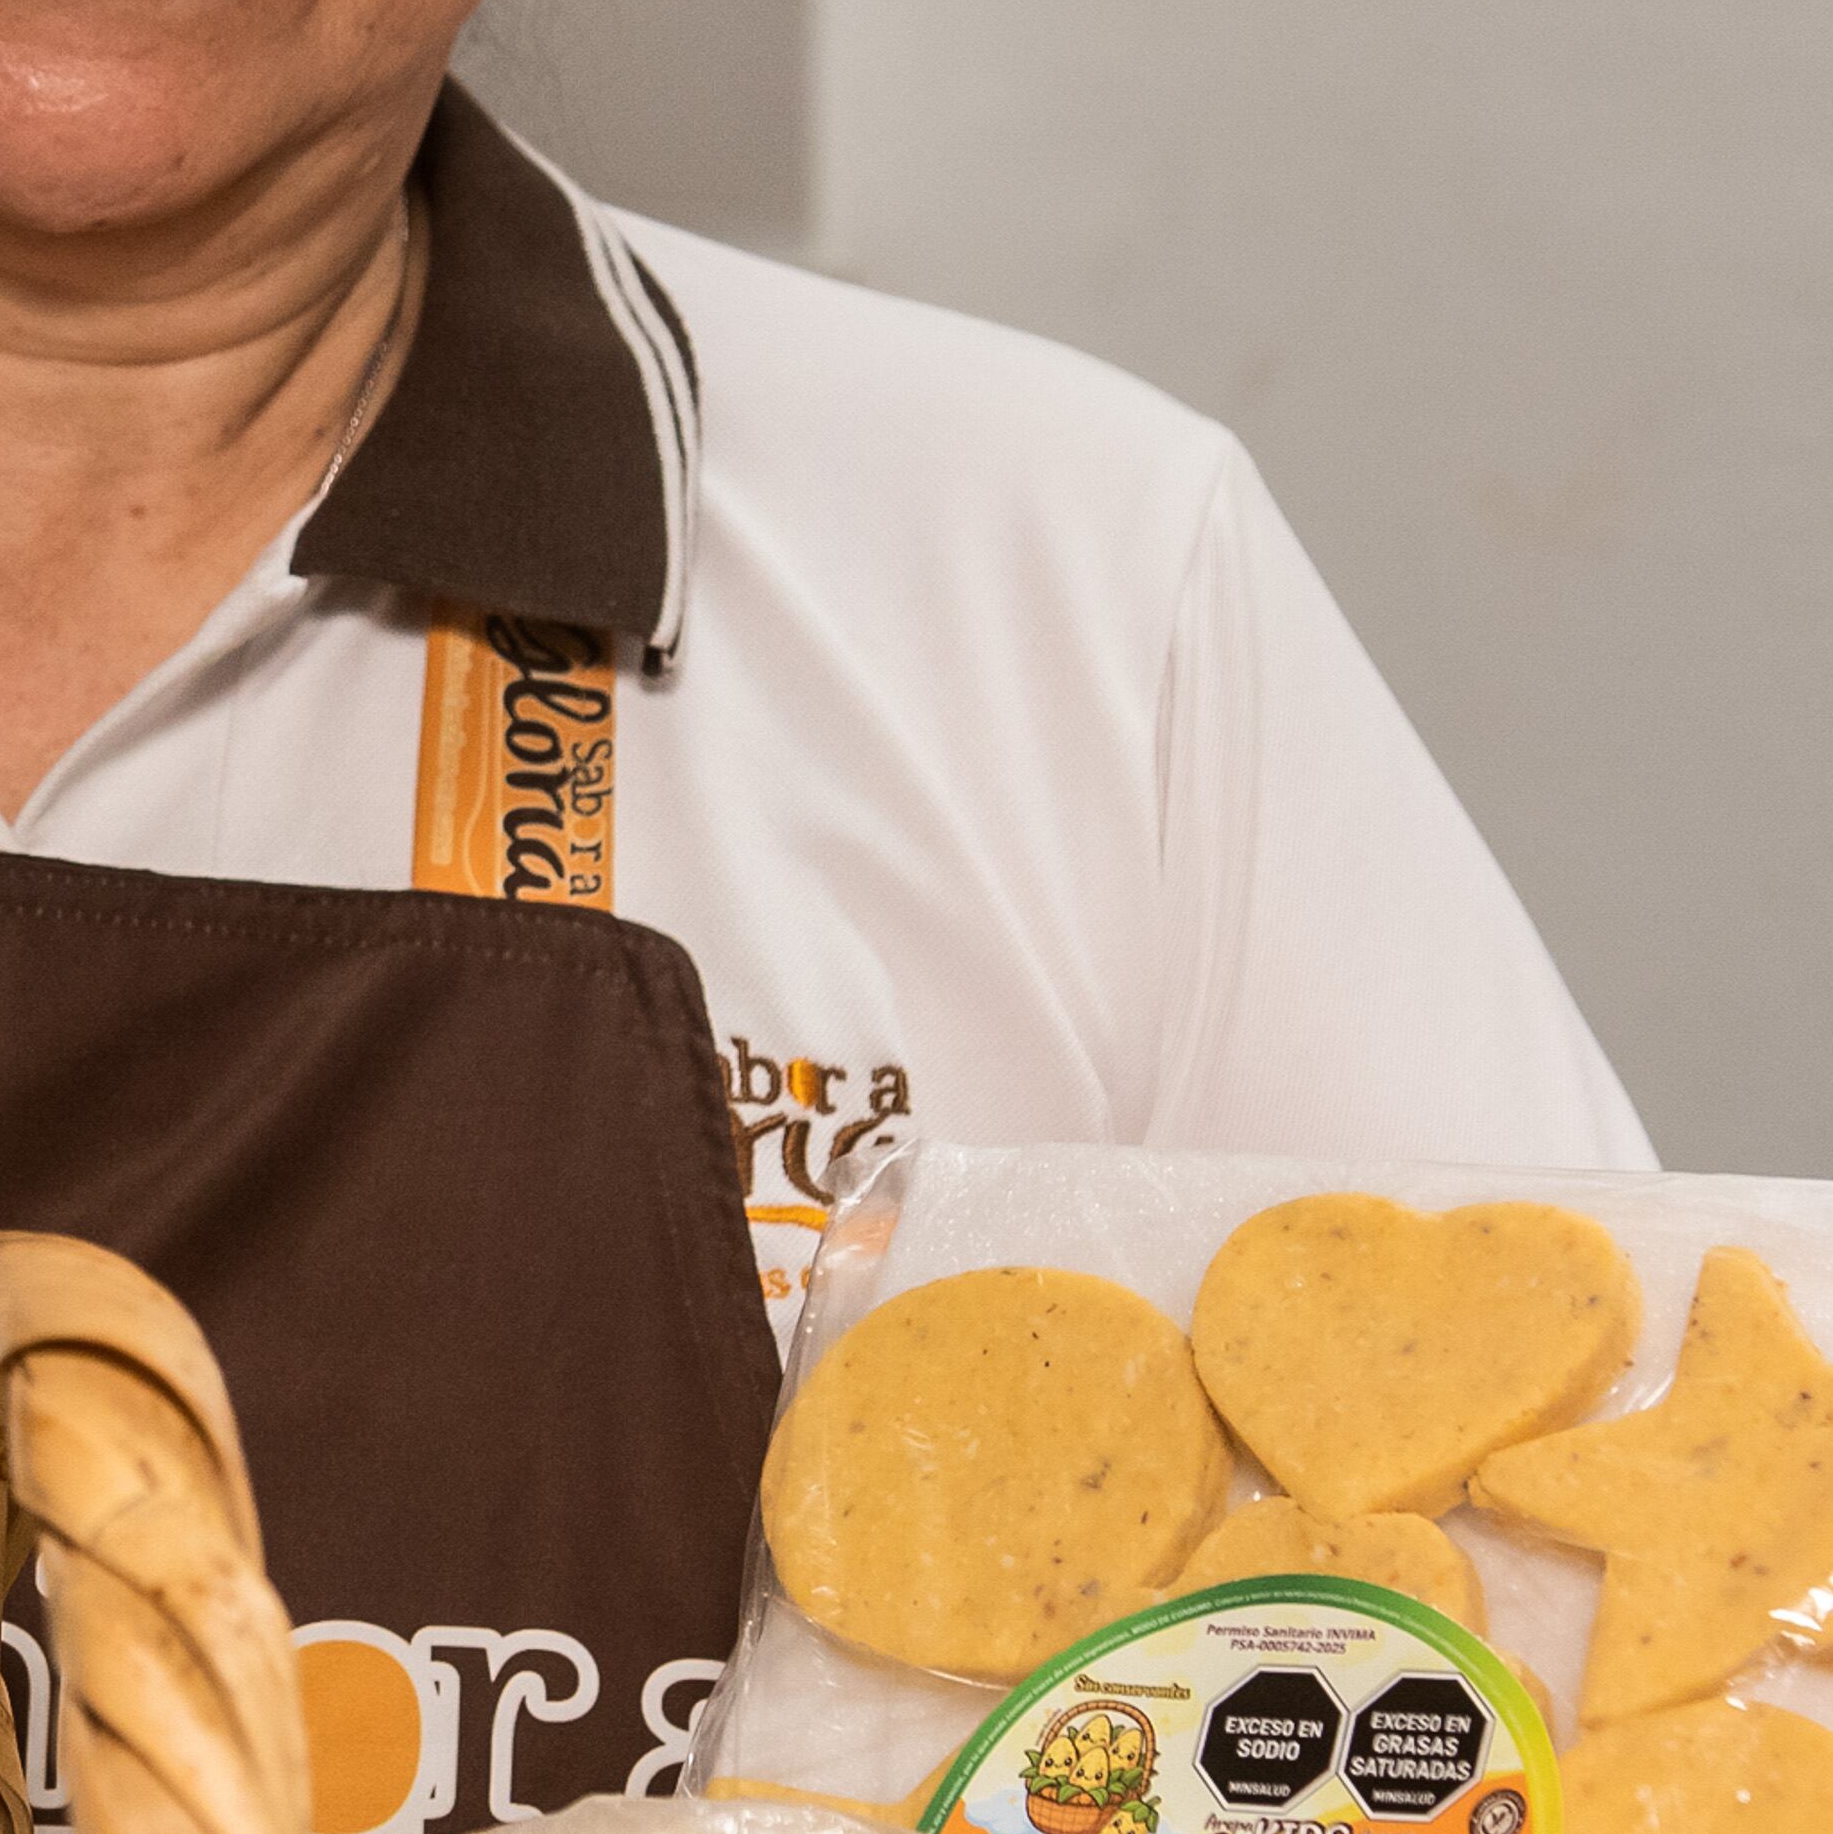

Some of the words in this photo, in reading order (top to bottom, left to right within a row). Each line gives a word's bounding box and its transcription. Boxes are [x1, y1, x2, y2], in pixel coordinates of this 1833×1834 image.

[570, 738, 614, 864] Sabor
[569, 874, 602, 896] a
[716, 1035, 847, 1116] bor
[869, 1064, 911, 1116] a
[1206, 1623, 1261, 1637] Permiso
[1263, 1625, 1323, 1639] Sanitario
[1326, 1627, 1377, 1641] INVIMA
[1224, 1715, 1294, 1738] EXCESO
[1297, 1720, 1324, 1739] EN
[1370, 1710, 1441, 1733] EXCESO
[1444, 1714, 1472, 1735] EN
[1236, 1737, 1301, 1762] SODIO
[1372, 1732, 1460, 1759] GRASAS
[1349, 1756, 1473, 1783] SATURADAS
[1228, 1780, 1292, 1798] MINSALUD
[1372, 1789, 1437, 1807] MINSALUD
